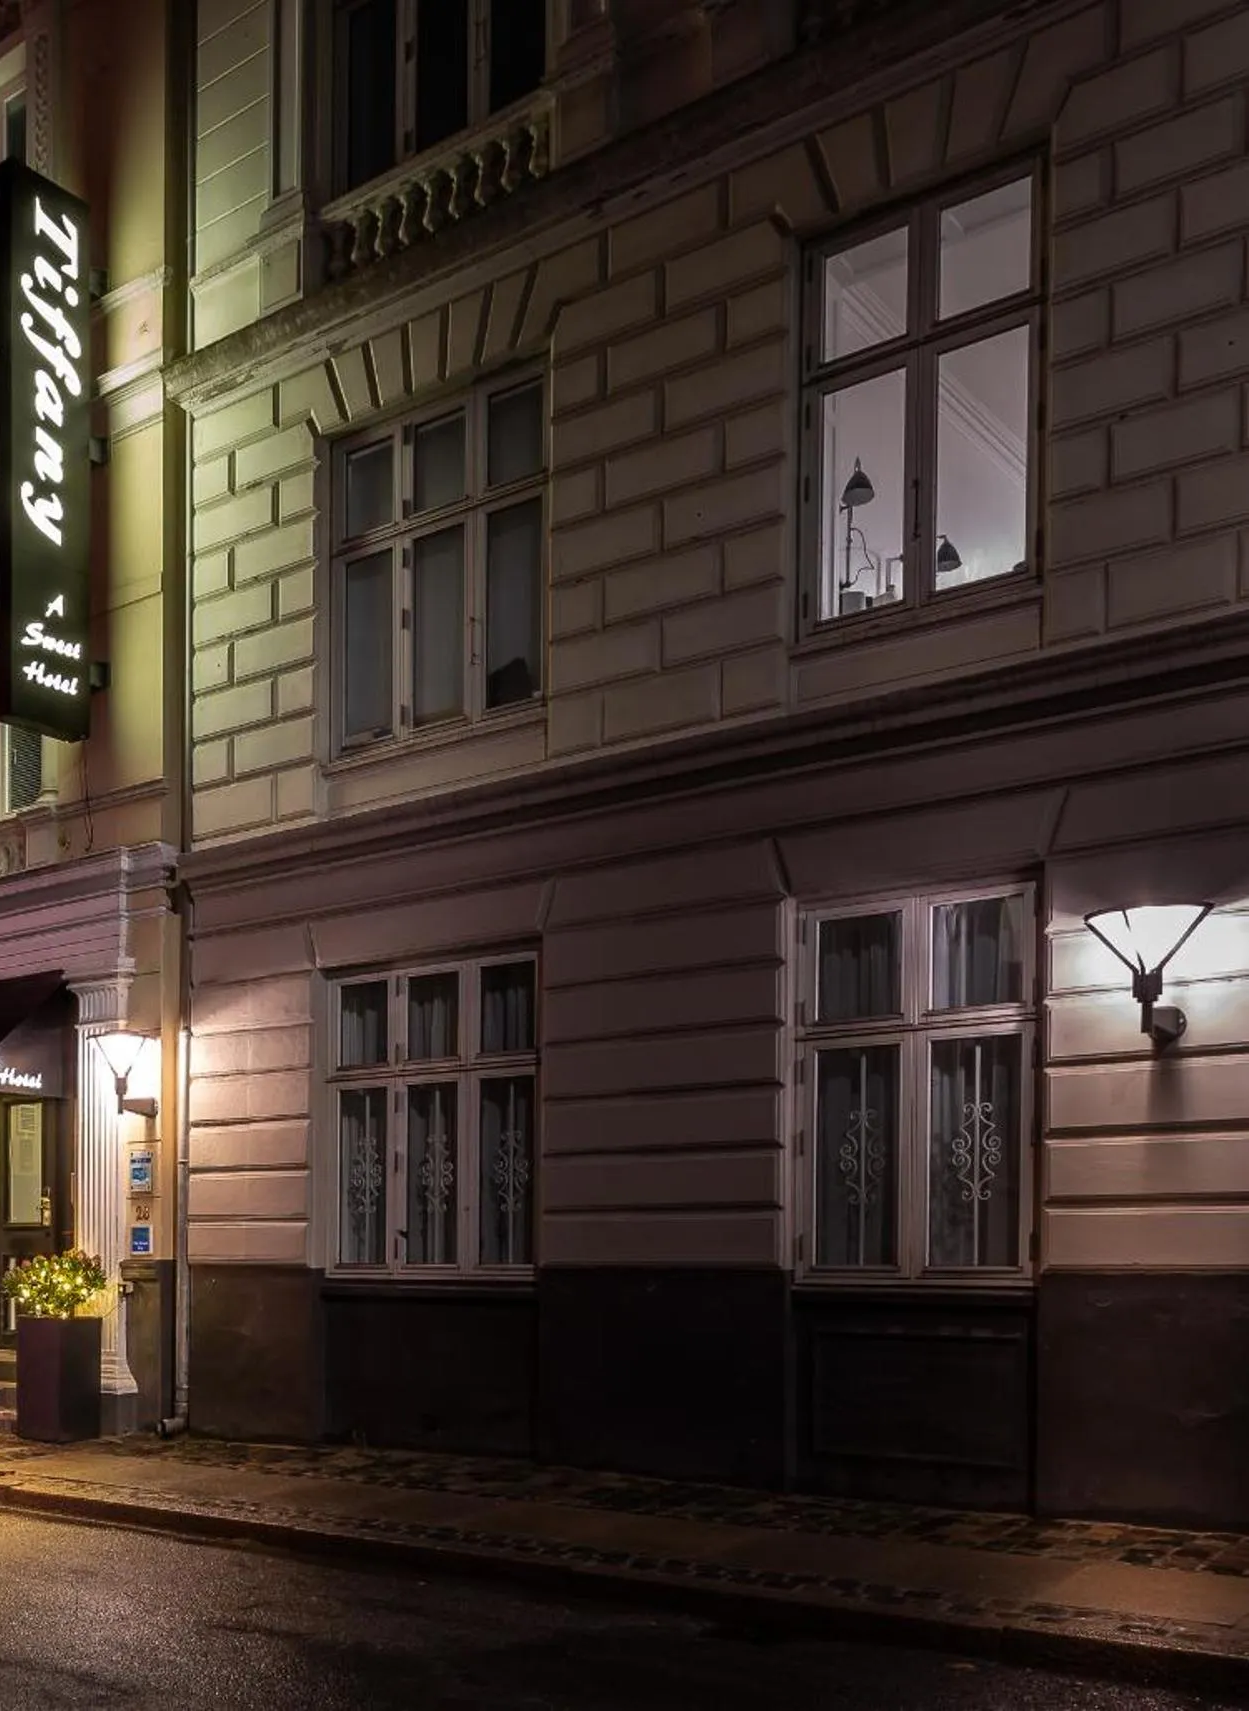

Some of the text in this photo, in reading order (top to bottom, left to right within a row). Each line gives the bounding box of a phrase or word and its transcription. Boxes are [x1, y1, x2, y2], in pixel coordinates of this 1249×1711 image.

[20, 197, 83, 546] Tiffany
[45, 594, 64, 617] A
[21, 622, 81, 659] Sweet
[22, 661, 79, 695] Hotel
